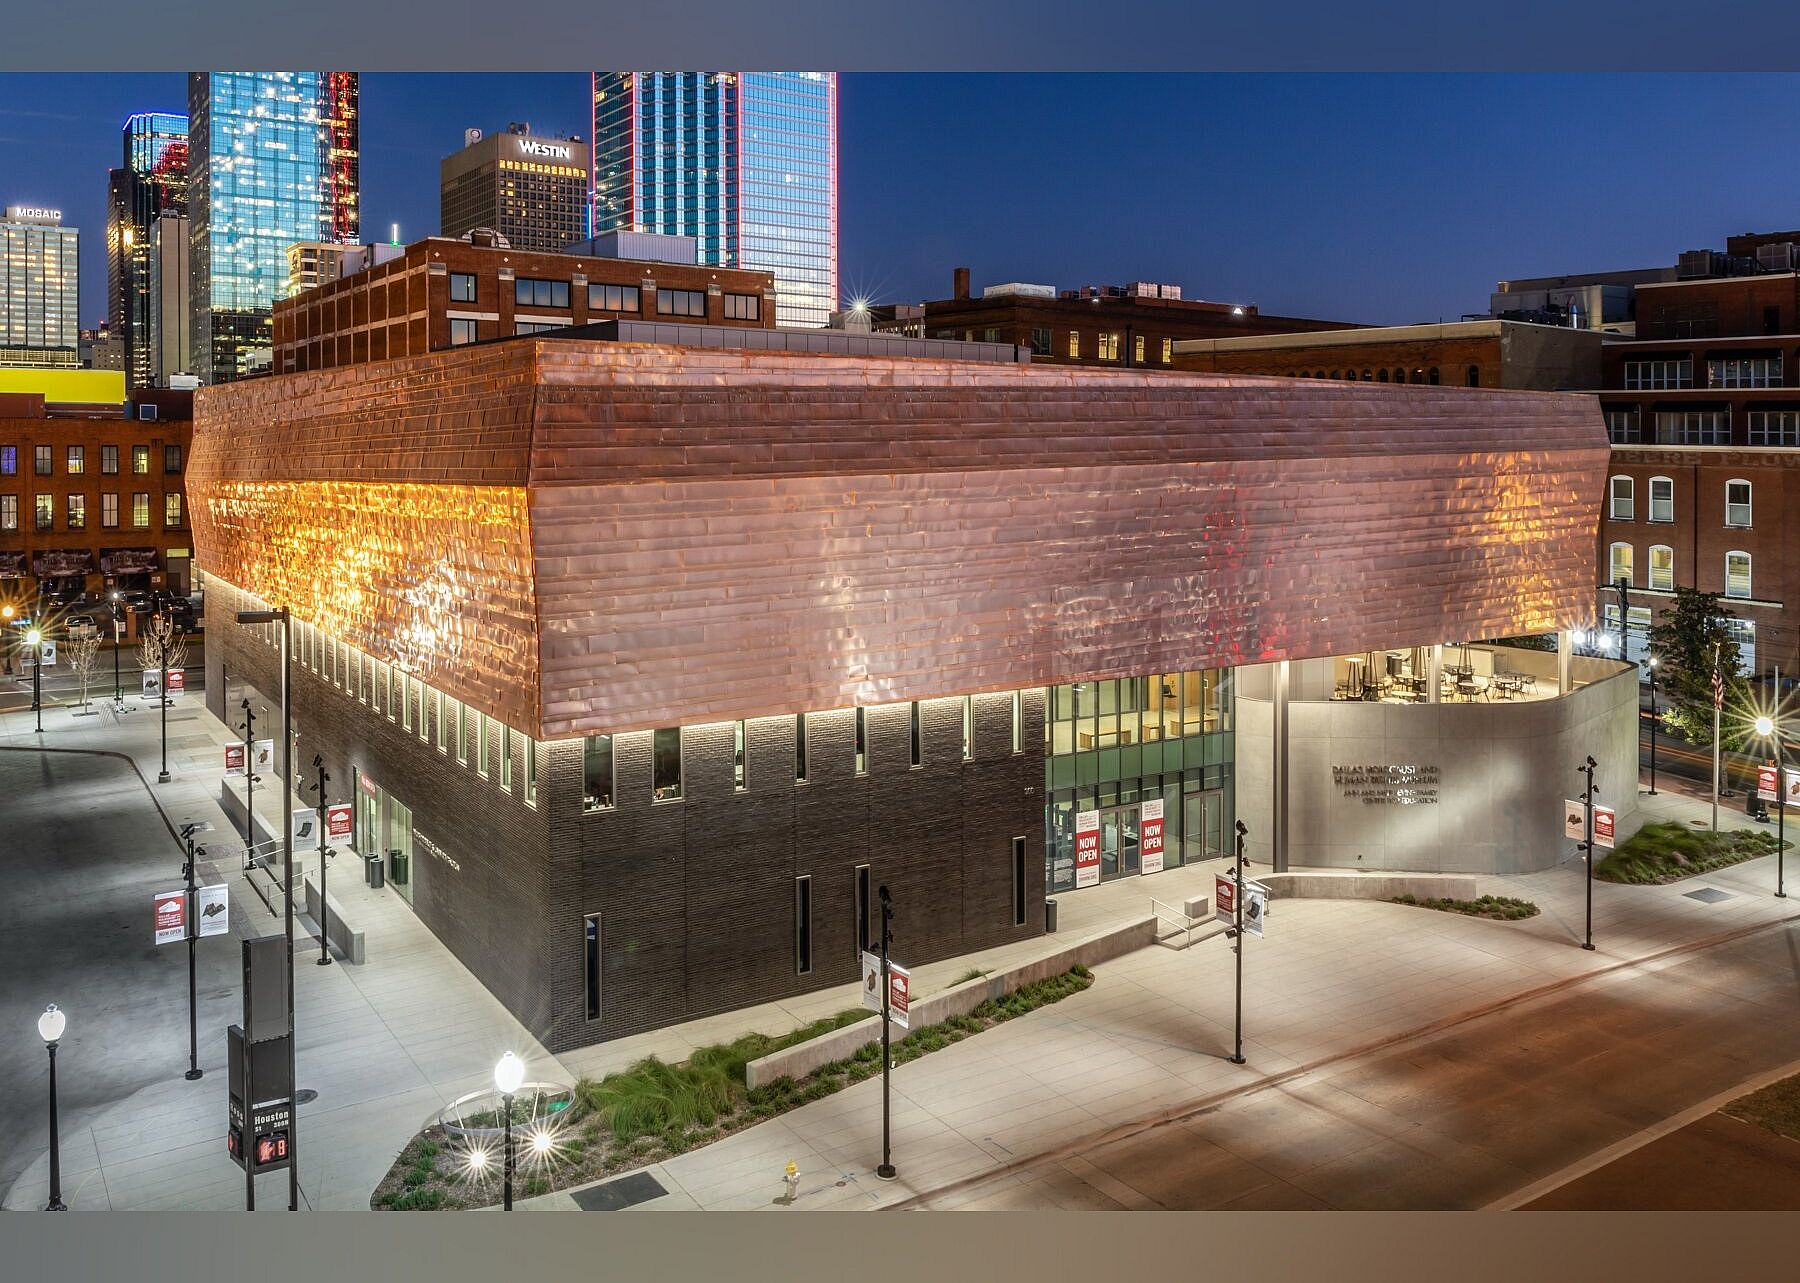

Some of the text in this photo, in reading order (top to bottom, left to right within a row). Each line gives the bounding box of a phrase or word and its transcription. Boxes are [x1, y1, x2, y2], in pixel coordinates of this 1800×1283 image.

[519, 140, 569, 159] WESTIN
[16, 207, 61, 219] MOSAIC
[1145, 824, 1161, 837] NOW
[1079, 836, 1096, 849] NOW
[1144, 837, 1162, 849] OPEN
[1078, 849, 1097, 863] OPEN
[255, 1111, 289, 1125] Houston
